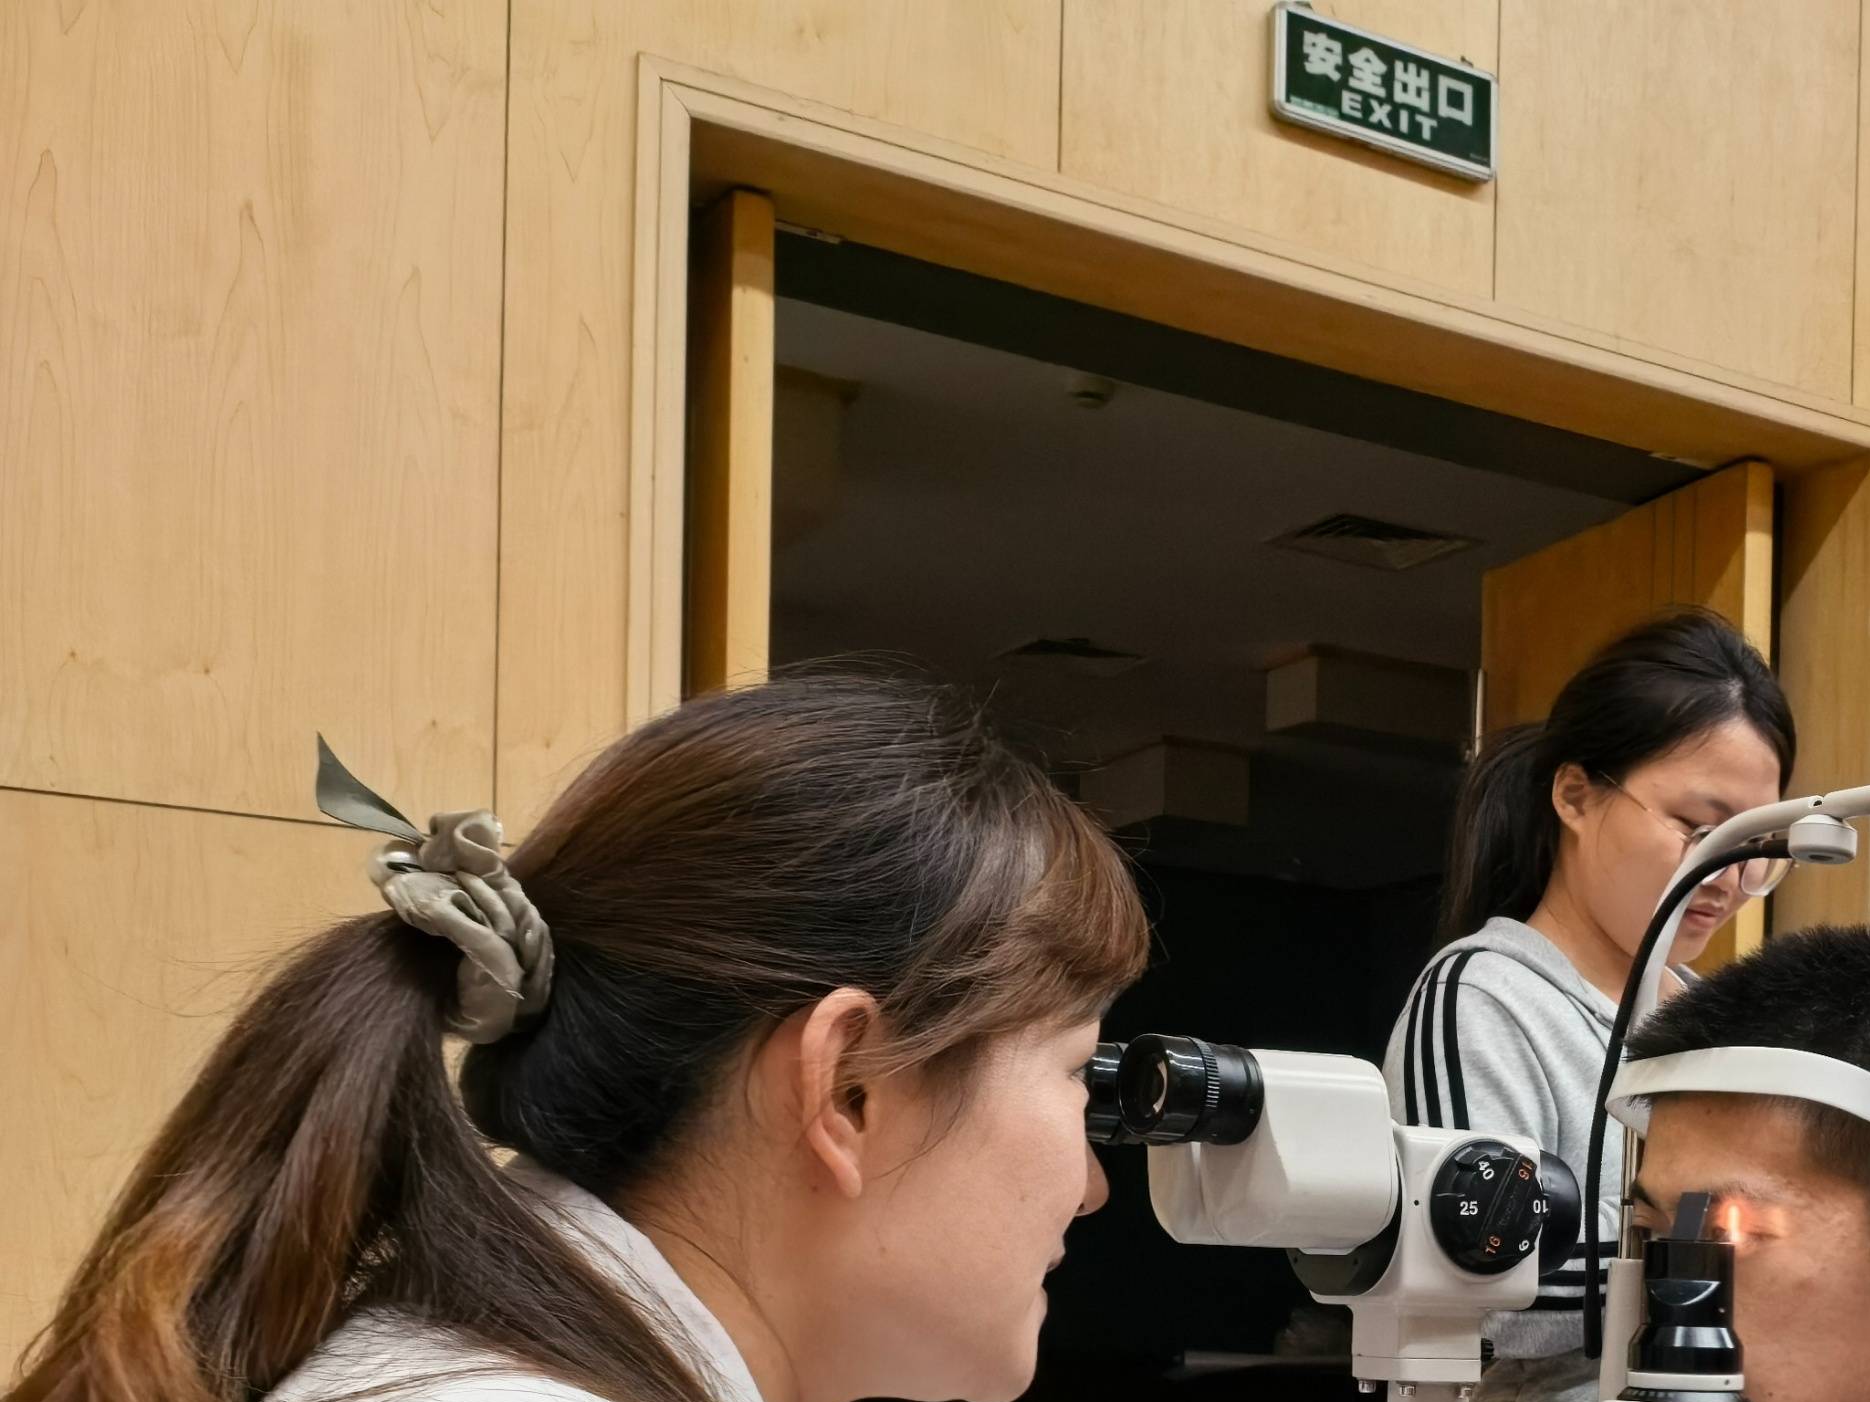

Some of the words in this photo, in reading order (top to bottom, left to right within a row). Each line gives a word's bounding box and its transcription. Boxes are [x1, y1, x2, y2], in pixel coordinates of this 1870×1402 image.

[1303, 30, 1473, 126] 安全出口
[1341, 89, 1438, 141] EXIT
[1478, 1160, 1495, 1180] 40
[1460, 1201, 1478, 1215] 25
[1533, 1200, 1548, 1214] 10
